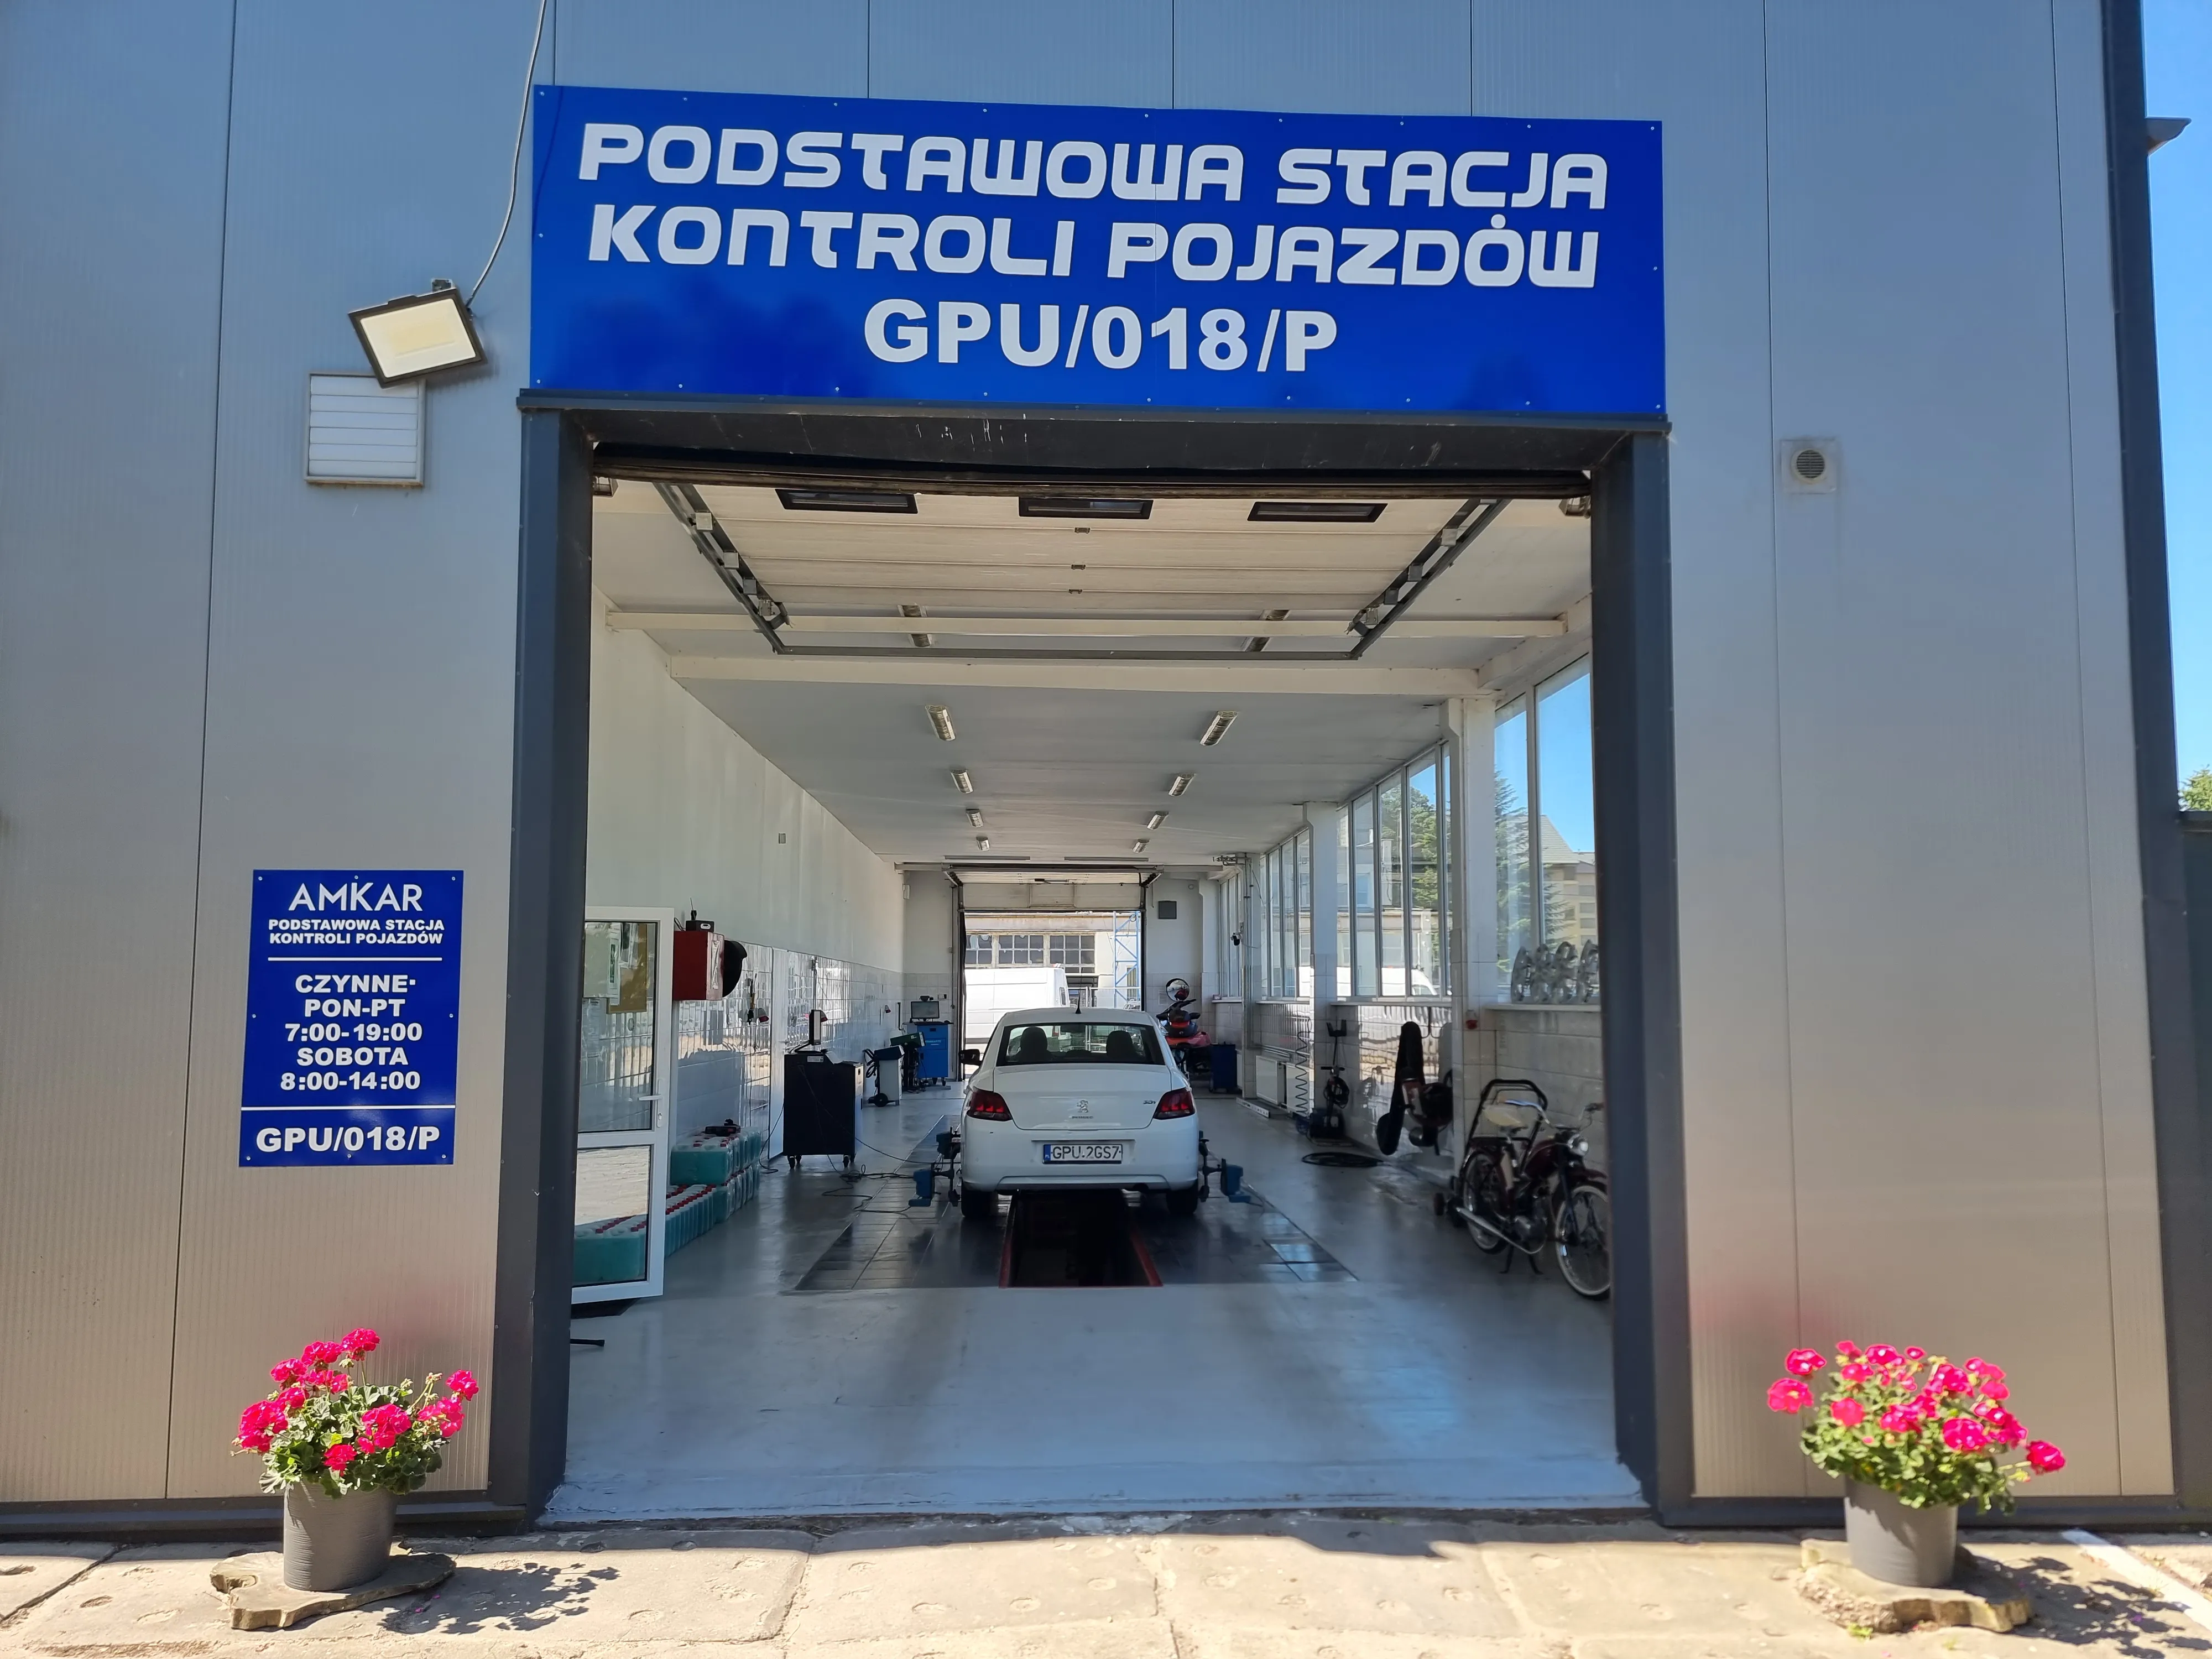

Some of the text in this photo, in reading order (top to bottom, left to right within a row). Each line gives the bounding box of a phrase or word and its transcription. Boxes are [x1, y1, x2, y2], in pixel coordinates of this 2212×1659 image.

[578, 123, 1608, 210] PODSTAWOWA STACJA
[588, 204, 1075, 276] KONTROLI
[864, 299, 1337, 372] GPU/018/P
[288, 882, 423, 911] AMKAR
[268, 919, 445, 931] PODSTAWOWA STACJA
[269, 931, 443, 944] KONTROLI POJAZDÓW
[305, 999, 406, 1018] PON-PT
[296, 1047, 409, 1066] SOBOTA
[280, 1071, 420, 1091] 8:00-14:00
[256, 1126, 440, 1152] GPU/018/P
[1052, 1146, 1081, 1159] GPU
